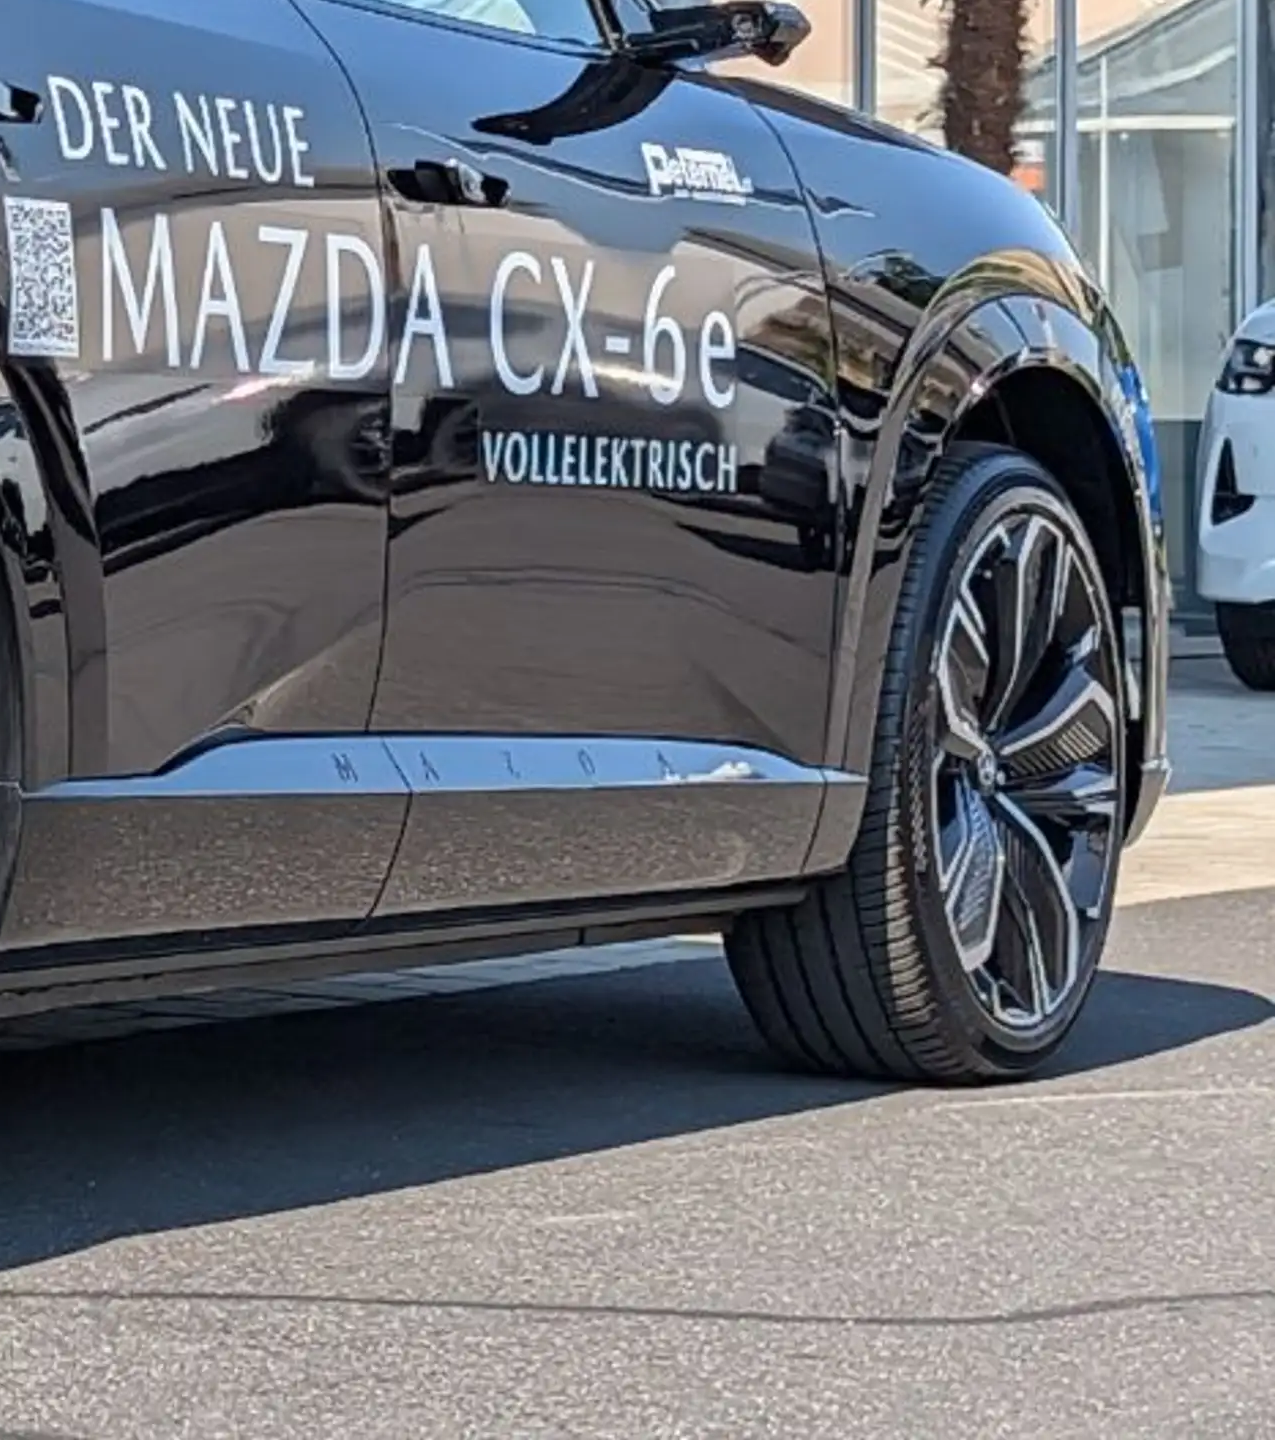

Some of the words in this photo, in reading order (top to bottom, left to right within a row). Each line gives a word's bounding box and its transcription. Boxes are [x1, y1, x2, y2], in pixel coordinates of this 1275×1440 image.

[47, 74, 167, 171] DER
[173, 90, 315, 188] NEUE
[102, 207, 455, 390] MAZDA
[489, 250, 737, 409] CX-6e
[482, 429, 739, 493] VOLLELEKTRISCH
